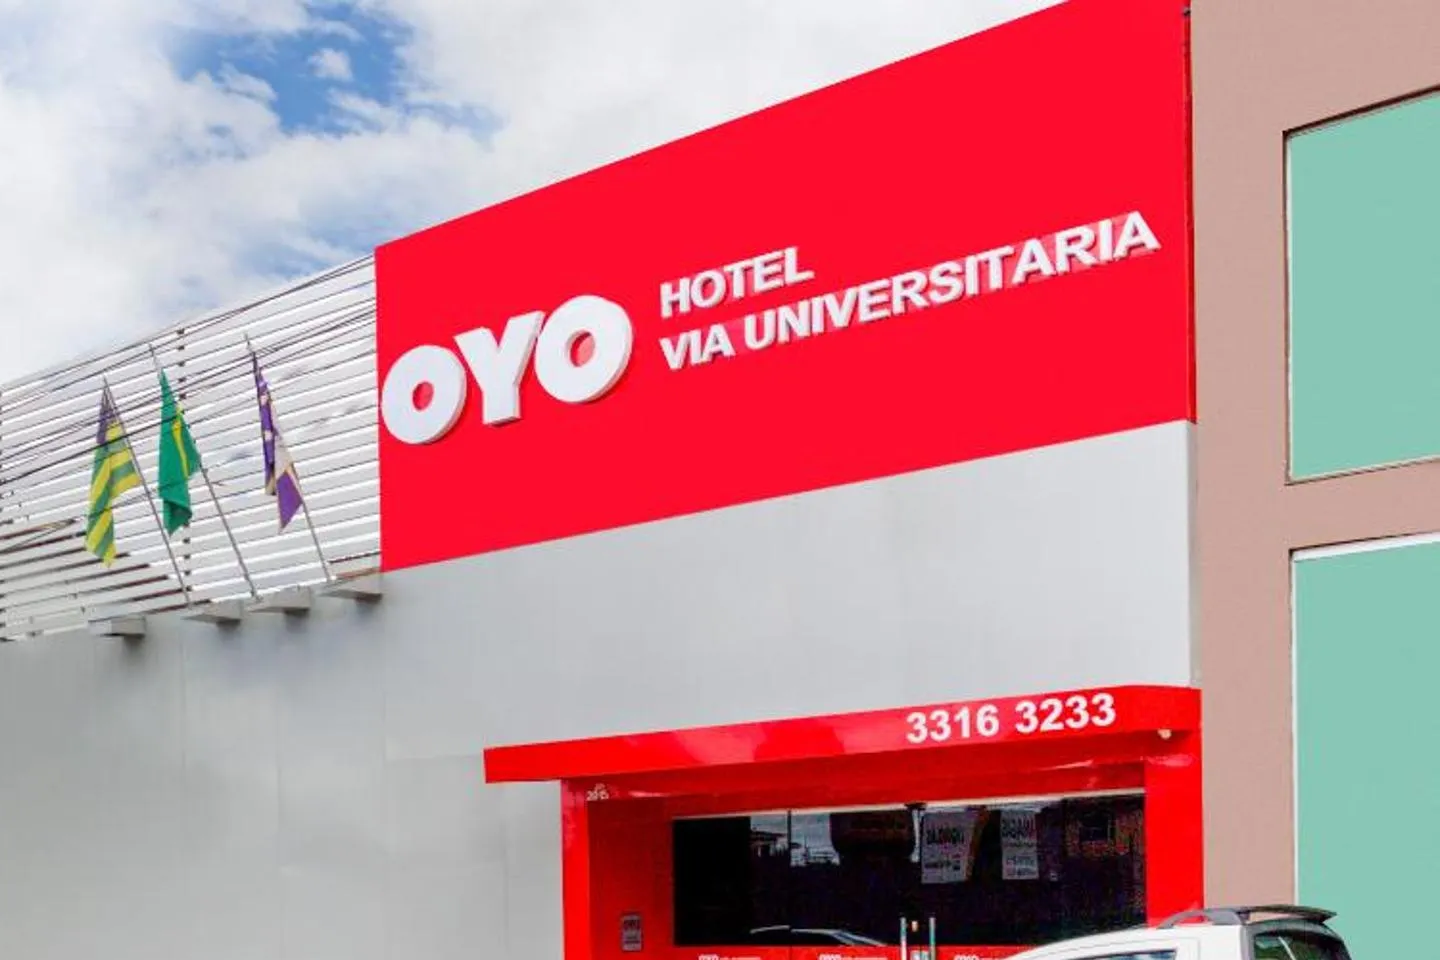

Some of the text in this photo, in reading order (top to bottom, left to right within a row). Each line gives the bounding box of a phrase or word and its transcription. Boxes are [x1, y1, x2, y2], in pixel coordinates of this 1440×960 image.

[659, 210, 1162, 371] VIA UNIVERSITARIA
[660, 246, 815, 319] HOTEL
[381, 295, 632, 444] OYO
[906, 692, 1117, 744] 3316 3233
